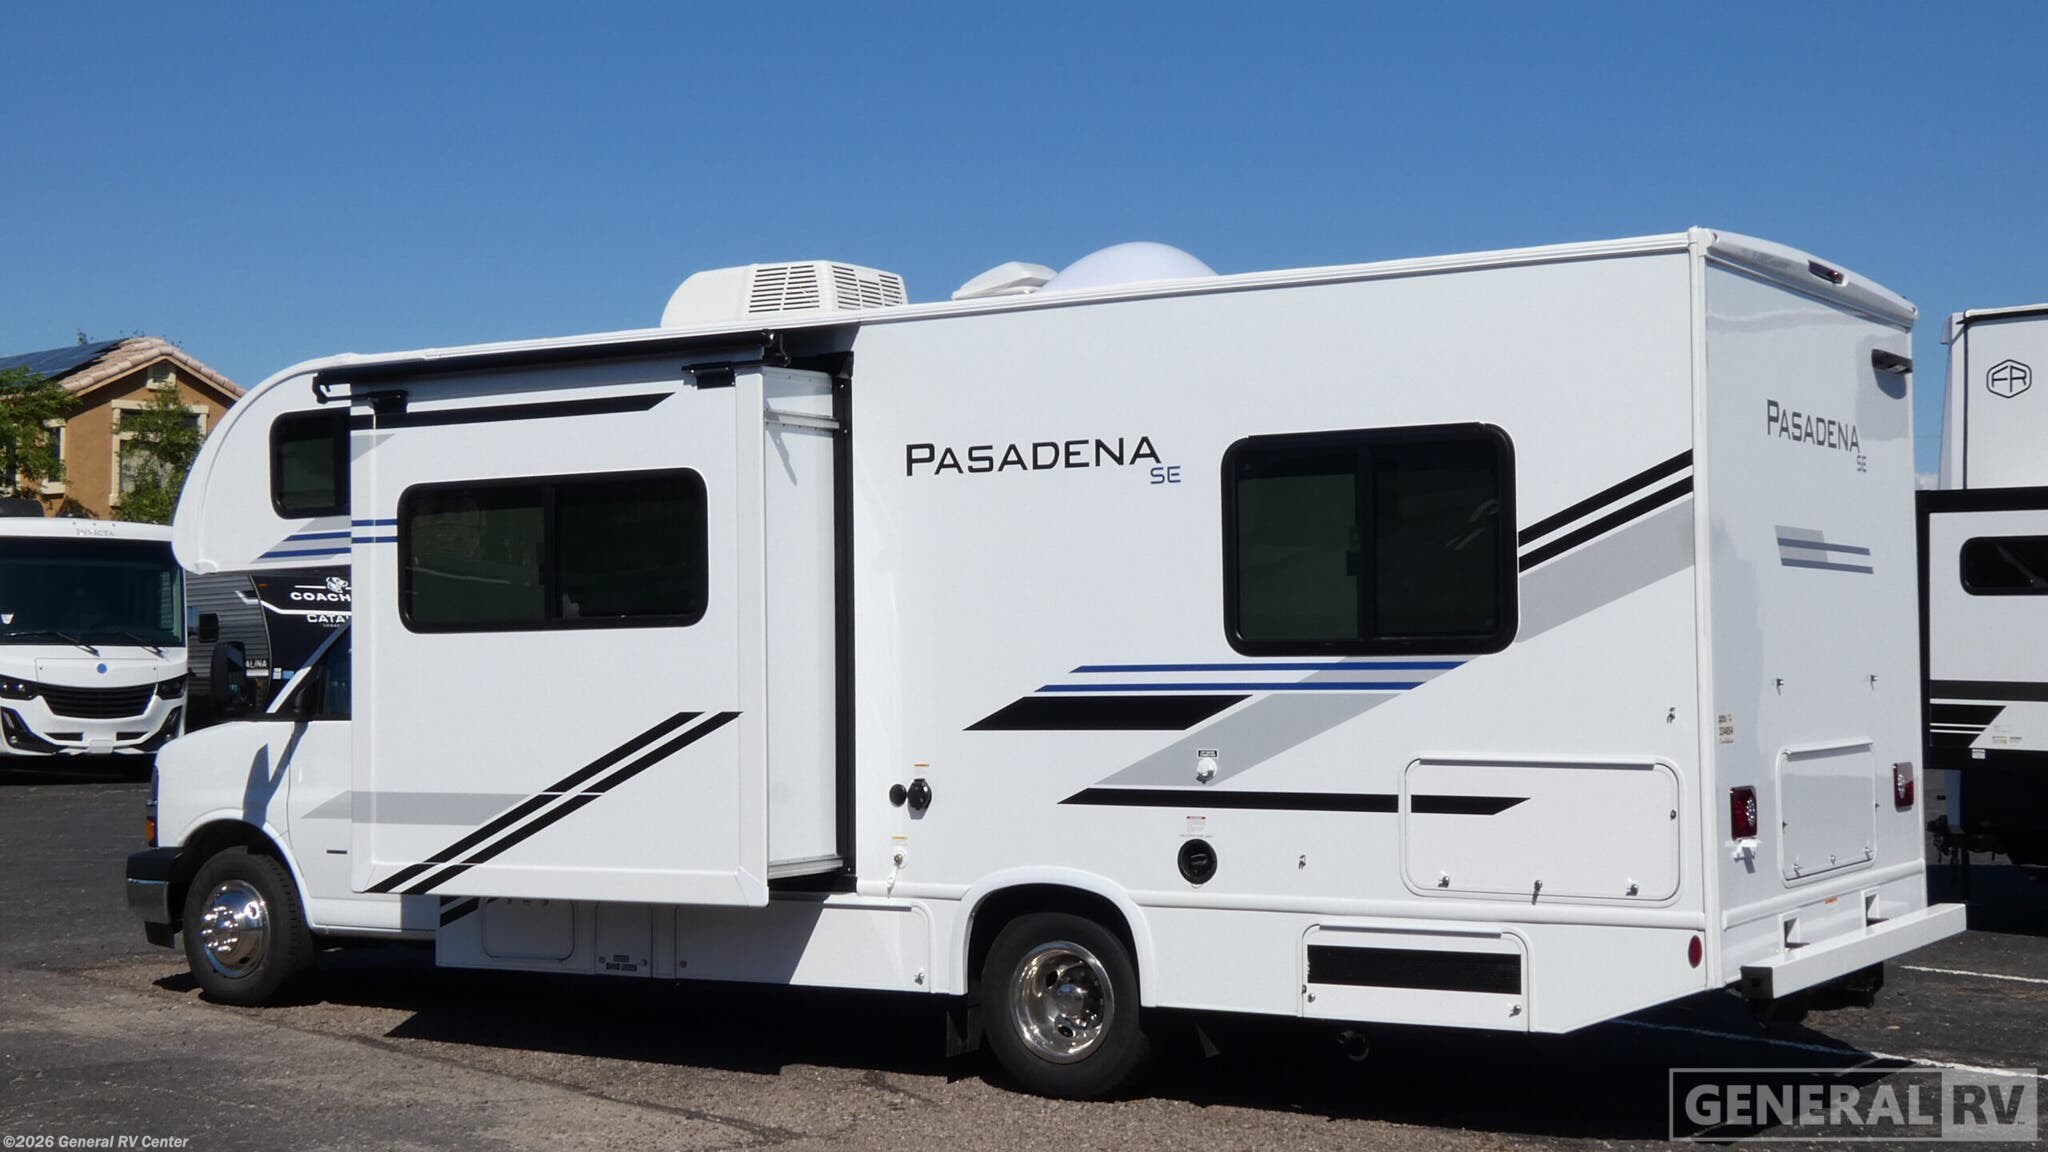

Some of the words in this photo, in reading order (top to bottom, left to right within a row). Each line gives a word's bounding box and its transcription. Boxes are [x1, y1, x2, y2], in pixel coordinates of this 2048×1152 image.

[1767, 399, 1860, 453] PASADENA
[906, 436, 1162, 476] PASADENA
[1857, 455, 1867, 473] SE
[1150, 466, 1181, 484] SE
